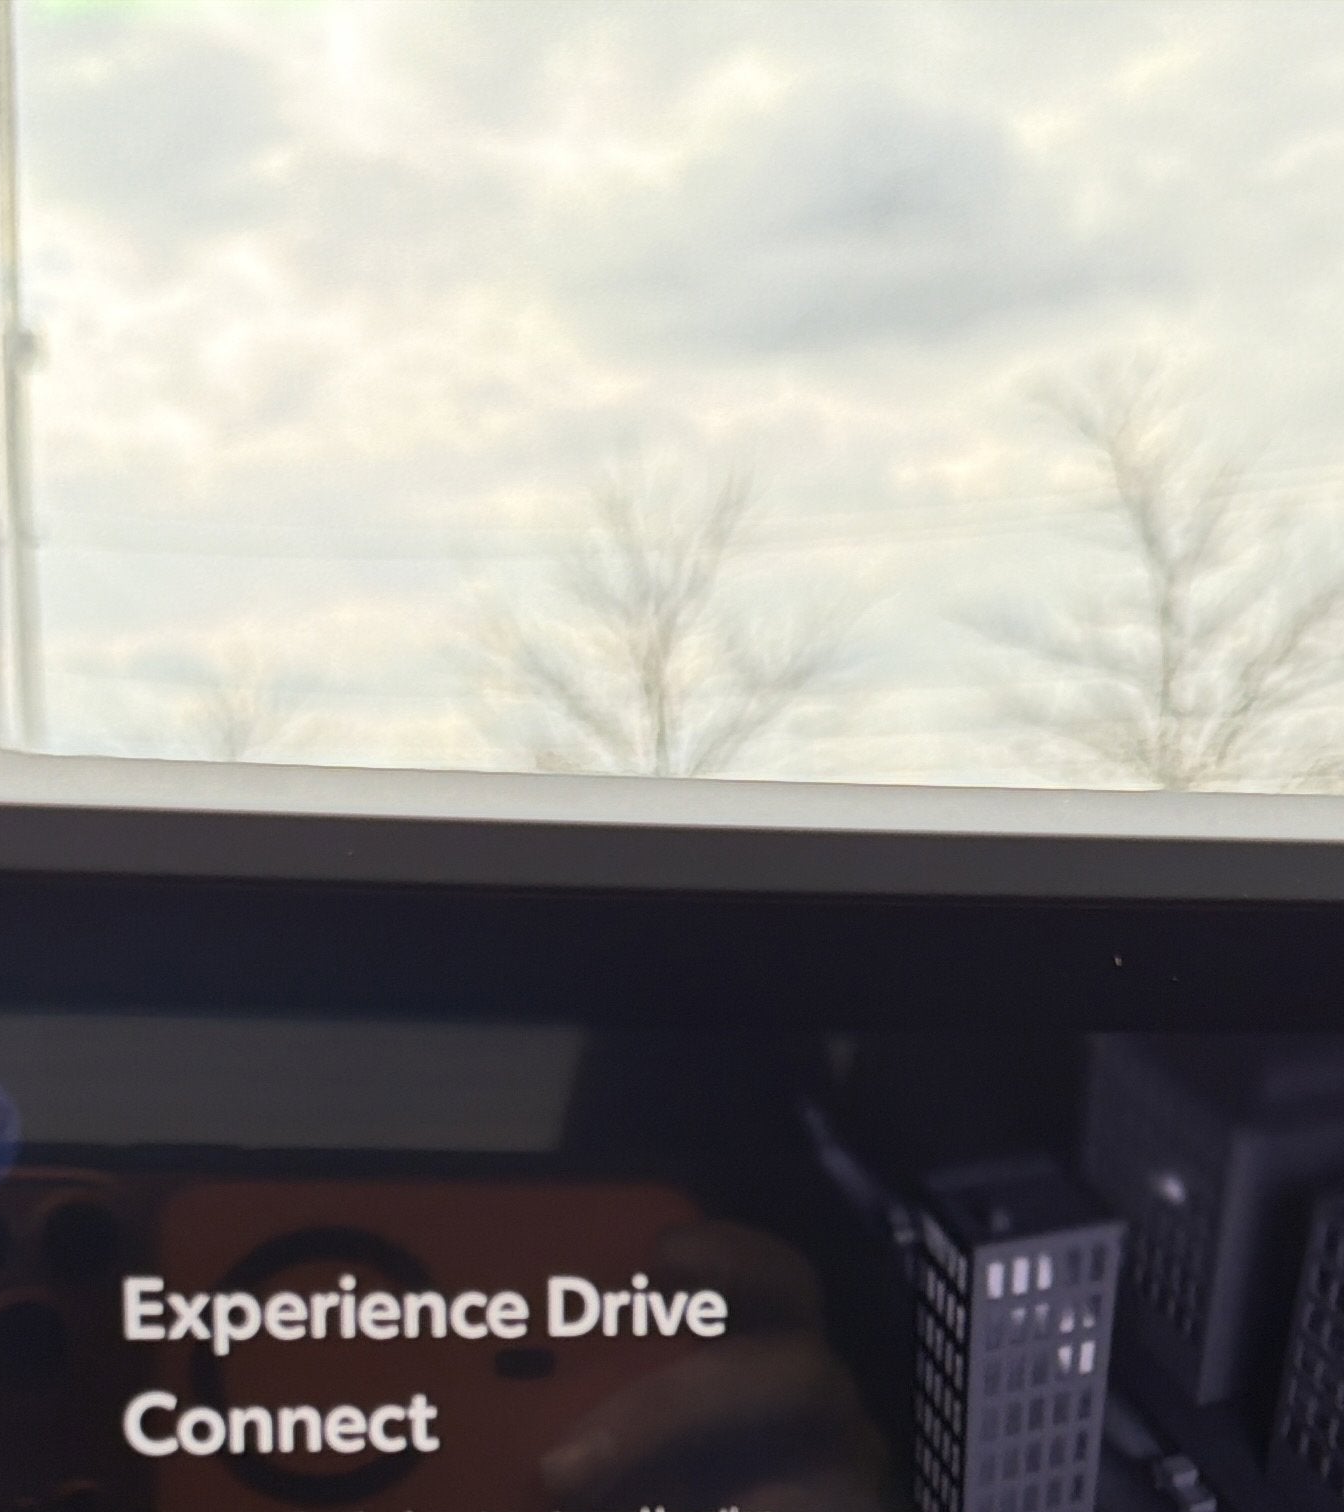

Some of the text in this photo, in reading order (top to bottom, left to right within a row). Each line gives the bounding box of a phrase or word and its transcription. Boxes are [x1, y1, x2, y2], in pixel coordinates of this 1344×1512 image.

[121, 1274, 728, 1355] Experience Drive
[123, 1390, 441, 1455] Connect
